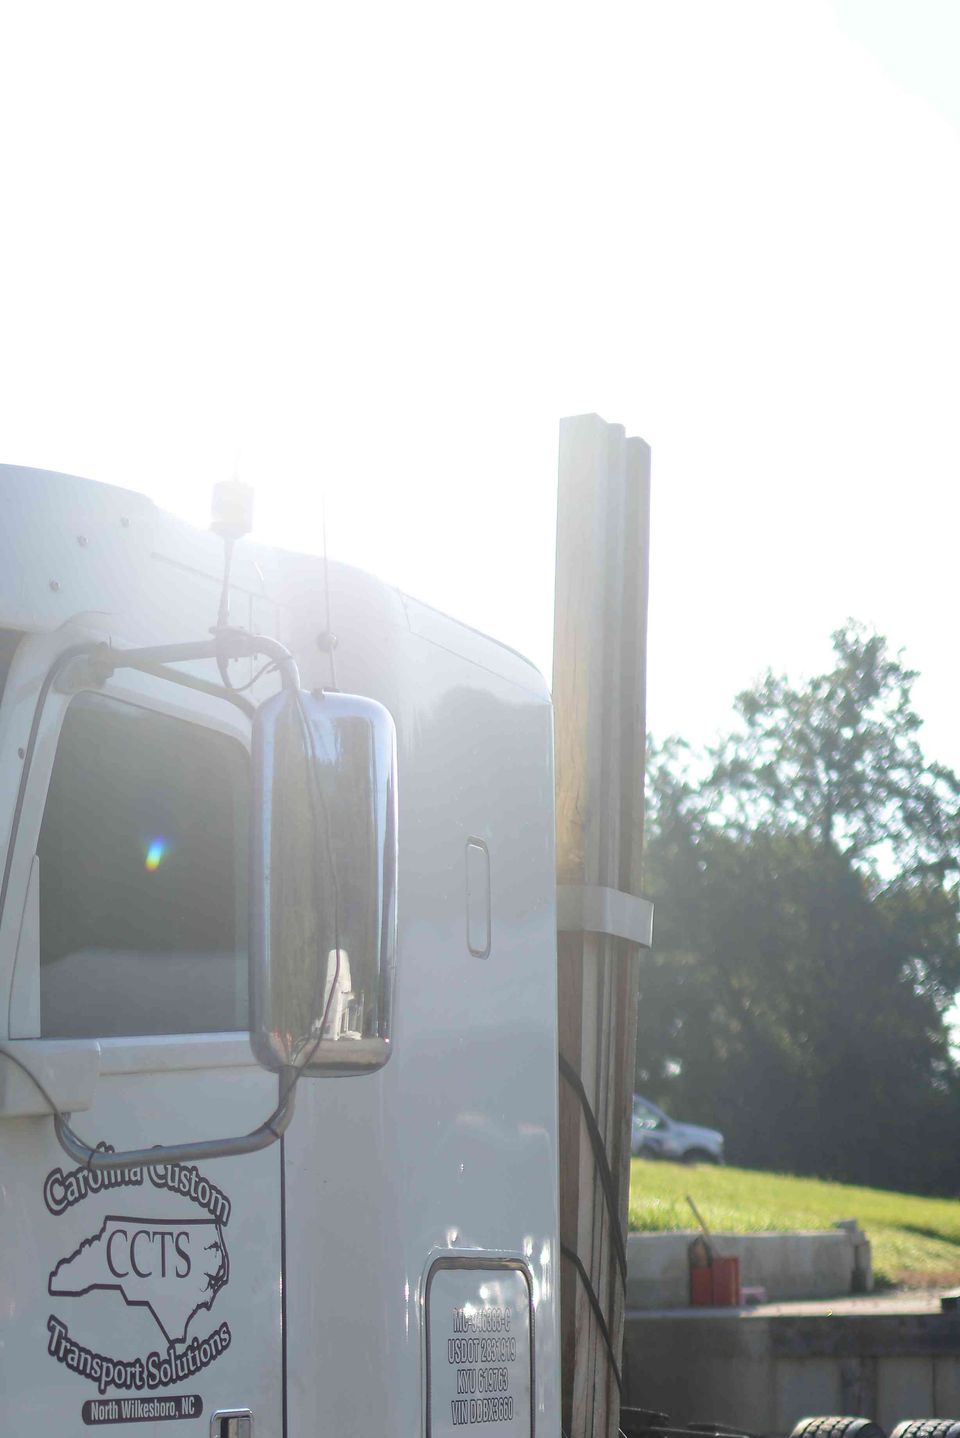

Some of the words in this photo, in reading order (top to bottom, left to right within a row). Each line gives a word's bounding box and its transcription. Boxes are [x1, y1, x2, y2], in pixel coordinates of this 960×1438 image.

[147, 1145, 231, 1227] Custom
[105, 1229, 191, 1279] CCTS
[47, 1314, 147, 1395] Transport
[147, 1322, 231, 1390] Solutions
[448, 1338, 480, 1364] USDOT
[481, 1336, 516, 1362] 2831919
[457, 1369, 476, 1394] KYU
[478, 1367, 508, 1393] 619763
[91, 1401, 118, 1421] North
[121, 1399, 179, 1418] Wilkesboro,
[181, 1397, 195, 1415] NC
[451, 1400, 468, 1425] VIN
[470, 1396, 513, 1424] DDBX3660
